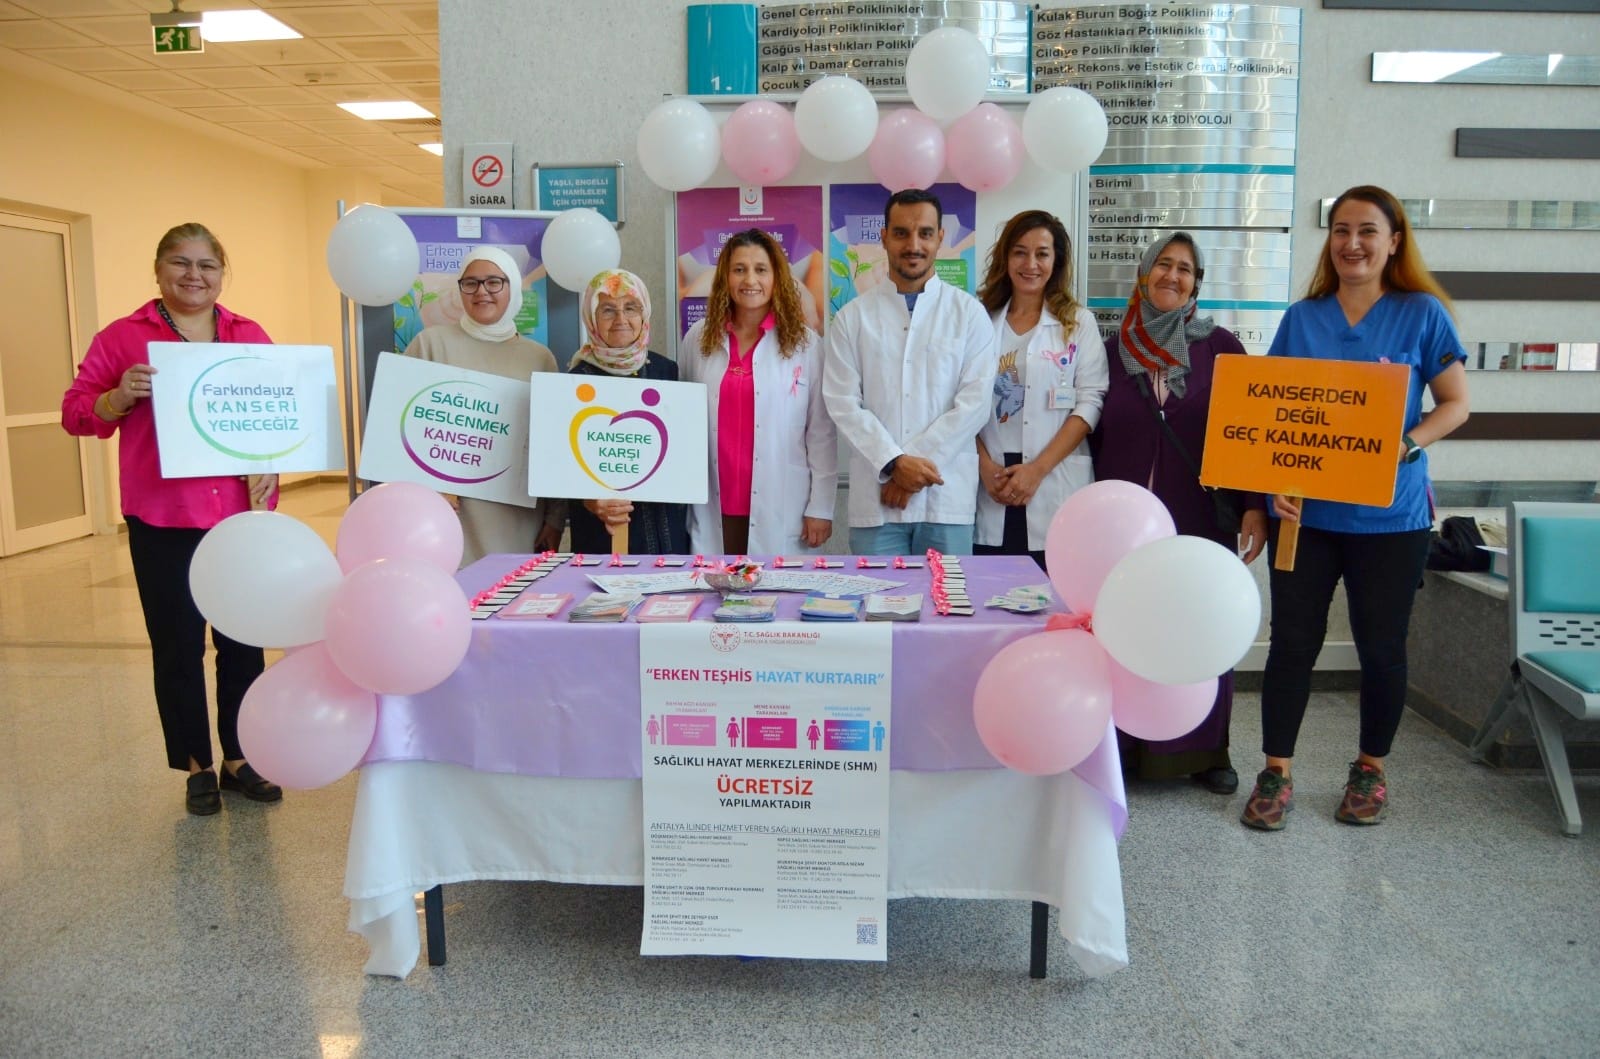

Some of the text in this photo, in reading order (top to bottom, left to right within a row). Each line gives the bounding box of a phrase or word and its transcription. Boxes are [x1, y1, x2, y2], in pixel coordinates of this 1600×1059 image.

[762, 4, 924, 20] Genel Cerrahi Poliklinikleri
[1036, 12, 1073, 22] Kulak
[1076, 10, 1115, 20] Burun
[1118, 9, 1157, 19] Boğaz
[762, 22, 905, 38] Kardiyoloji Poliklinikleri
[1036, 26, 1214, 40] Göz Hastalıkları Poliklinikleri
[762, 39, 914, 56] Göğüs Hastalıkları Polikli
[1036, 43, 1160, 58] Cildiye Poliklinikleri
[762, 57, 908, 74] Kalp ve Damar Cerrahis
[1035, 64, 1073, 75] Plastik
[1077, 62, 1124, 73] Rekons.
[1128, 63, 1141, 71] ve
[1144, 61, 1183, 71] Estetik
[1230, 63, 1292, 75] Poliklinikleri
[762, 80, 800, 91] Çocuk
[866, 76, 907, 87] Hastal
[1096, 79, 1173, 90] Poliklinikleri
[1151, 113, 1232, 125] KARDİYOLOJİ
[548, 178, 609, 188] YAŞLI, ENGELLİ
[1095, 178, 1132, 189] Birimi
[563, 188, 607, 196] HAMİLELER
[469, 194, 506, 205] SİGARA
[552, 198, 605, 207] İÇİN OTURMA
[861, 216, 886, 228] Erk
[861, 230, 881, 241] Hay
[1088, 233, 1148, 244] asta Kayıt
[425, 244, 463, 257] Erken
[1101, 250, 1136, 260] Hasta
[425, 258, 461, 271] Hayat
[202, 384, 294, 399] Farkındayız
[1247, 383, 1367, 406] KANSERDEN
[207, 398, 297, 413] KANSERİ
[431, 391, 499, 415] SAĞLIKLI
[413, 406, 510, 435] BESLENMEK
[1275, 406, 1331, 426] DEĞİL
[208, 416, 299, 432] YENECEĞİZ
[424, 427, 494, 451] KANSERİ
[587, 431, 652, 445] KANSERE
[1223, 425, 1382, 454] GEÇ KALMAKTAN
[429, 444, 482, 467] ÖNLER
[599, 447, 640, 461] KARŞI
[599, 462, 640, 474] ELELE
[1272, 452, 1323, 471] KORK
[756, 631, 780, 639] SAĞLIK
[782, 631, 821, 639] BAKANLIĞI
[703, 667, 752, 685] TEŞHİS
[756, 671, 801, 684] HAYAT
[654, 755, 878, 773] SAĞLIKLI HAYAT MERKEZLERİNDE (SHM)
[717, 774, 813, 796] ÜCRETSİZ
[719, 798, 812, 810] YAPILMAKTADIR
[650, 822, 685, 831] ANTALYA
[744, 825, 769, 833] VEREN
[771, 825, 805, 834] SAĞLIKLI
[806, 827, 831, 835] HAYAT
